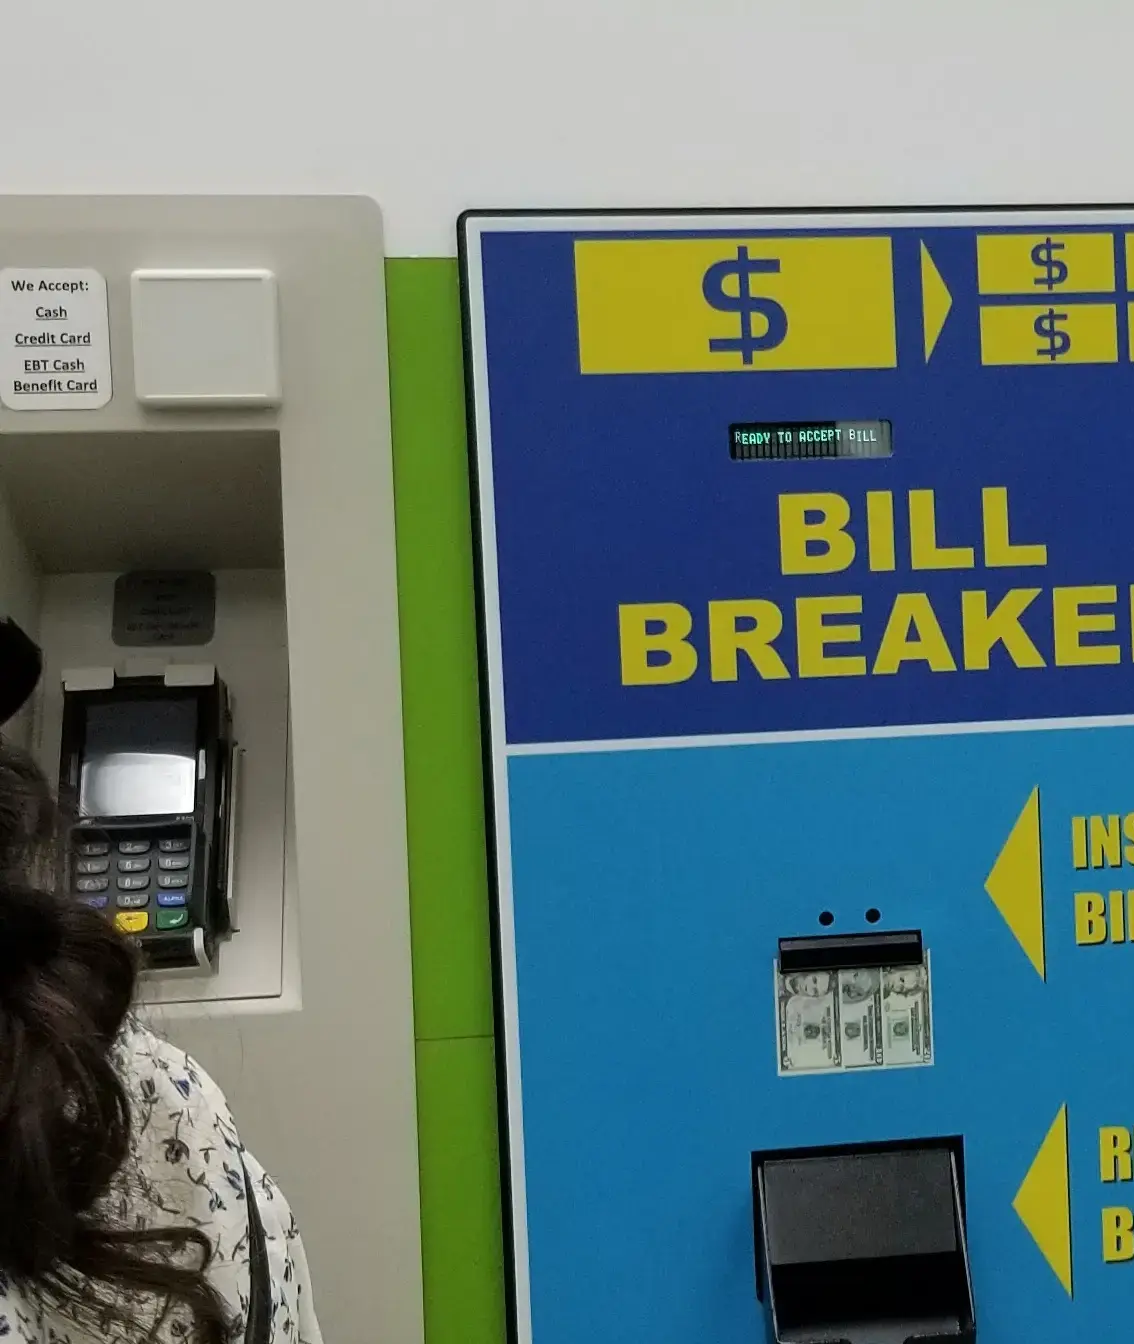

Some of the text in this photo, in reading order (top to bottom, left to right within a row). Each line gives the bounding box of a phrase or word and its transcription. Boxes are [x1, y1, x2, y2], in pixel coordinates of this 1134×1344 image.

[11, 280, 89, 294] We Accept:
[35, 306, 68, 320] Cash
[15, 332, 91, 346] Credit Card
[24, 358, 85, 373] EBT Cash
[14, 379, 98, 393] Benefit Card
[735, 428, 877, 445] READY TO ACCEPT BILL
[777, 486, 1048, 576] BILL
